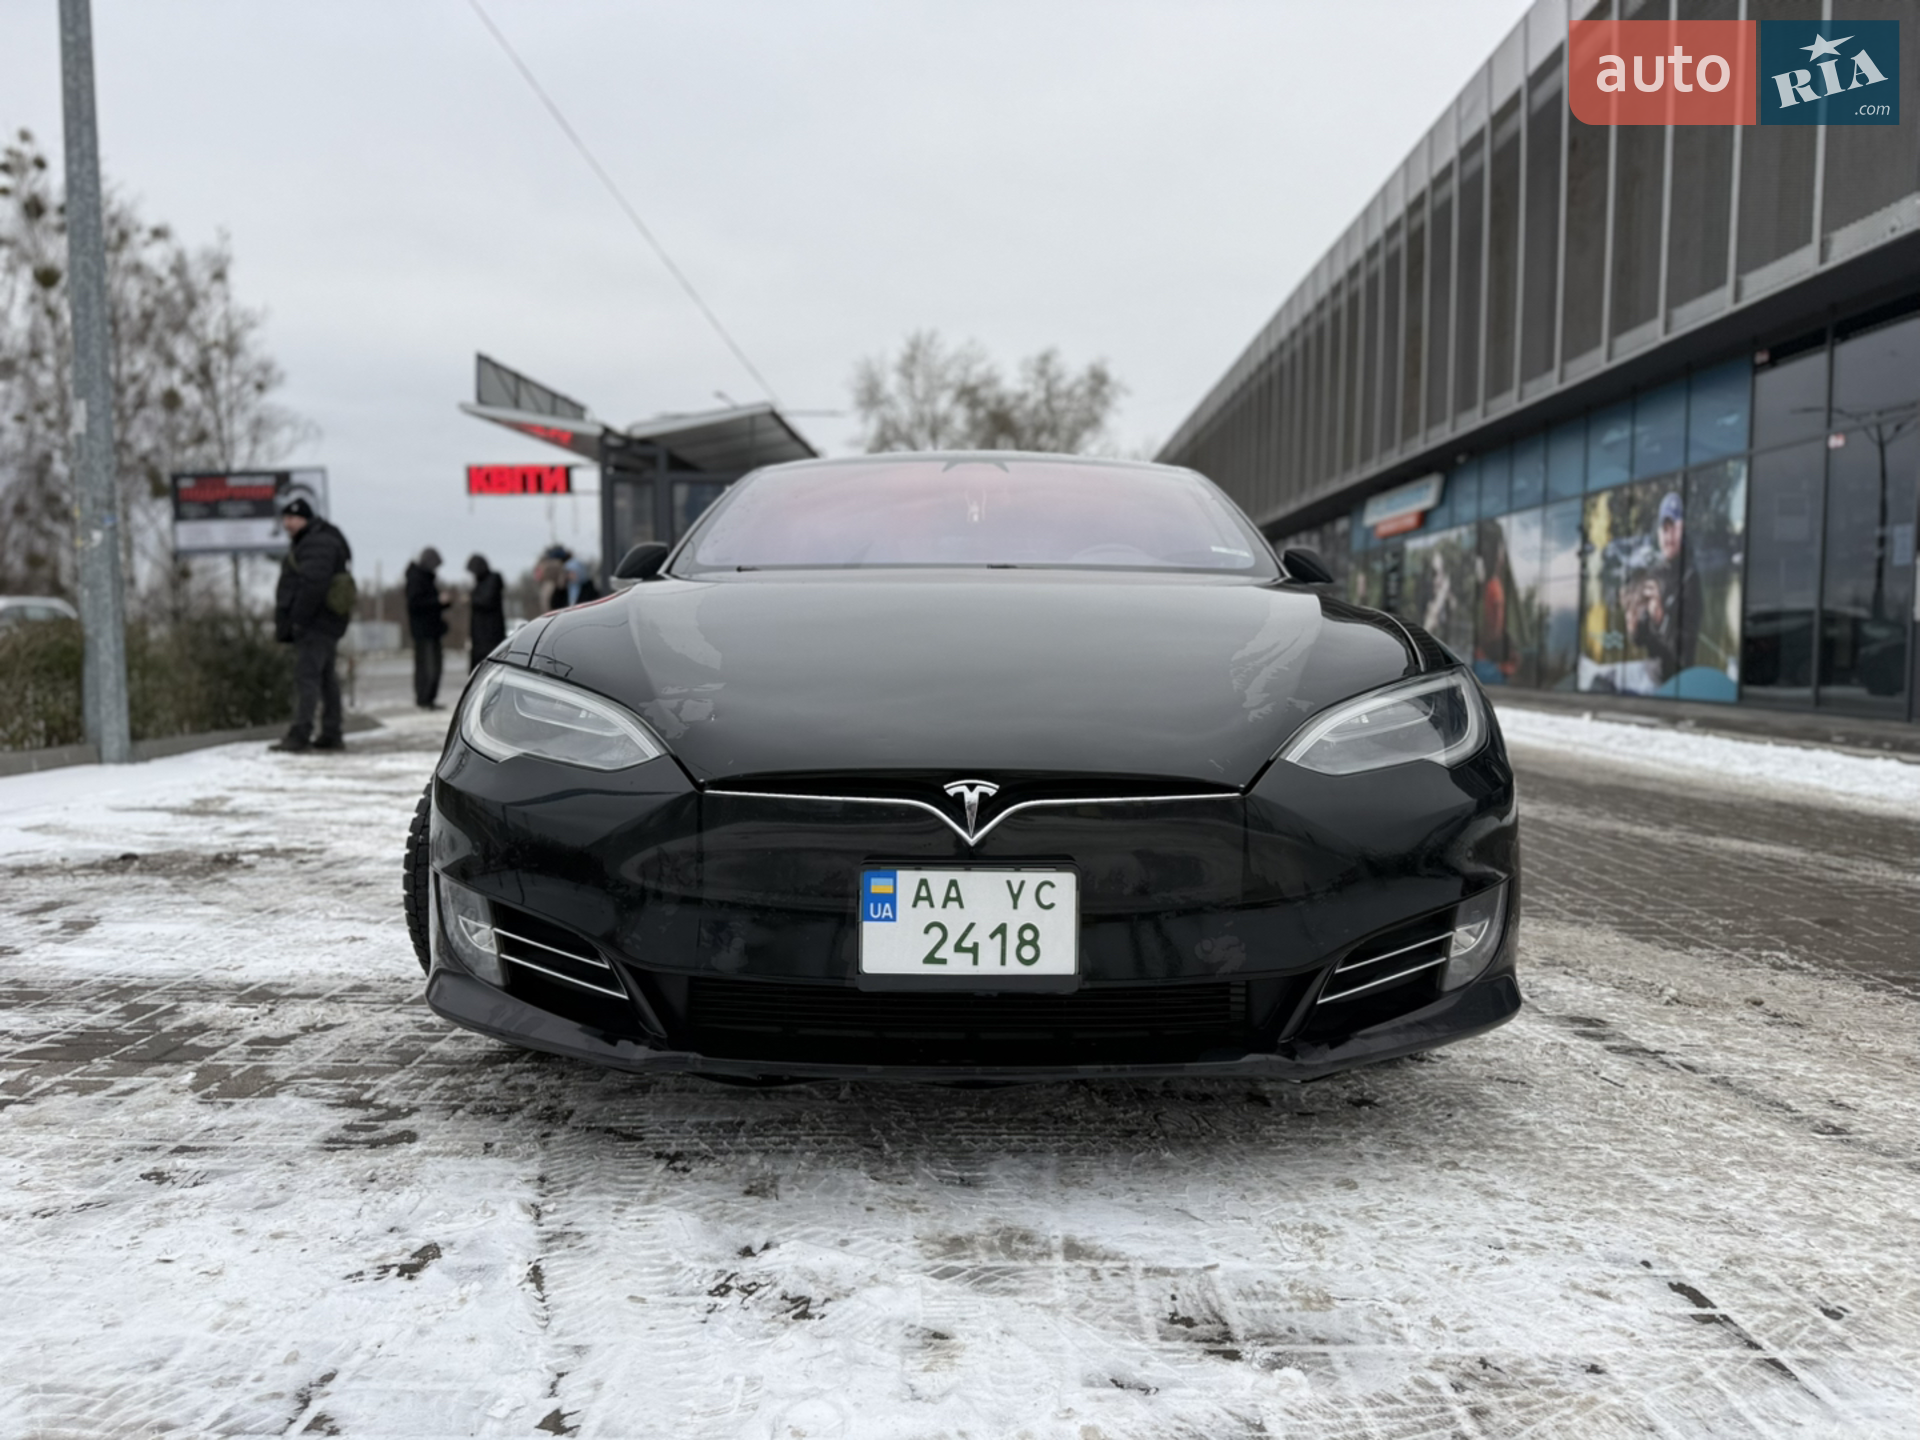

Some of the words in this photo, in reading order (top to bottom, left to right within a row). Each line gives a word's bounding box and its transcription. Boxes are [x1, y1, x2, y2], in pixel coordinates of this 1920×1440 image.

[468, 464, 567, 495] КВІТИ
[912, 878, 965, 909] AA
[1006, 880, 1056, 910] YC
[870, 903, 893, 919] UA
[922, 921, 1041, 966] 2418
